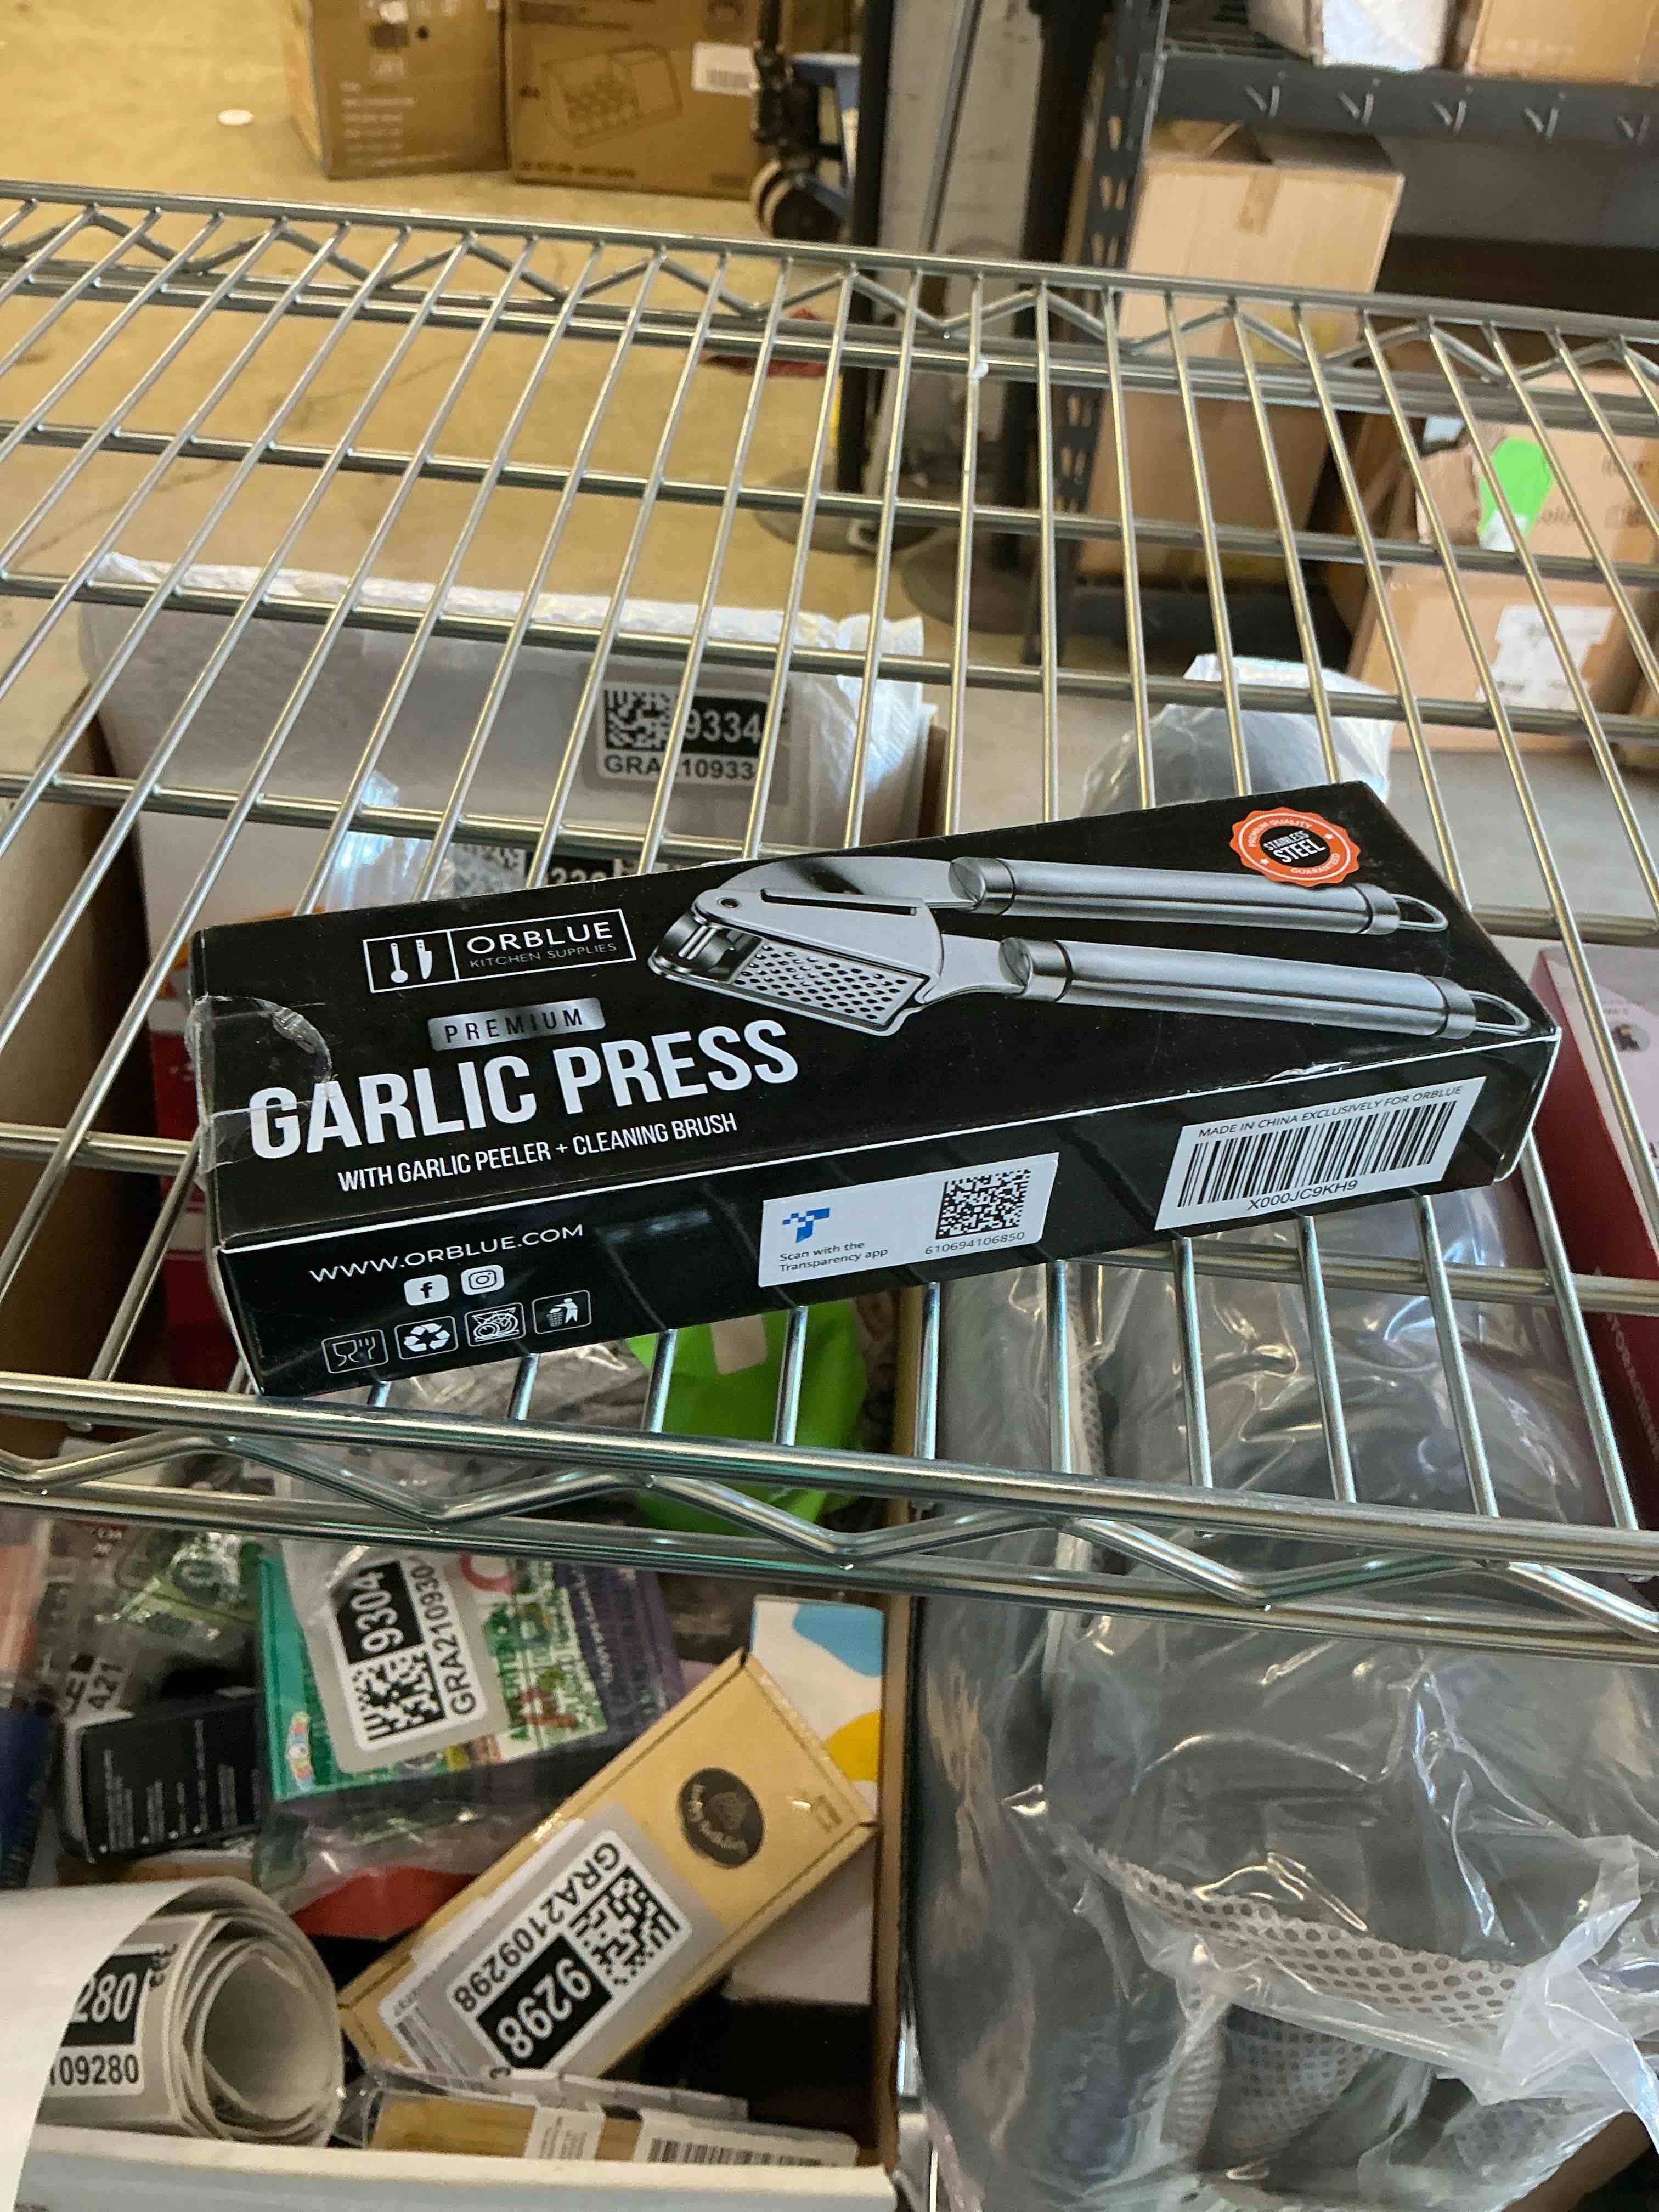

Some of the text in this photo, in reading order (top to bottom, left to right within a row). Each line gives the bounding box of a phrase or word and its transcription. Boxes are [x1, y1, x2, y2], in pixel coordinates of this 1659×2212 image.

[685, 709, 763, 745] 9334
[1263, 830, 1310, 851] STAINLESS
[1269, 819, 1313, 829] QUALITY
[1273, 838, 1326, 863] STEEL
[467, 922, 613, 954] ORBLUE
[469, 943, 618, 968] KITCHEN SUPPLIES
[445, 1008, 584, 1043] PREMIUM
[248, 1019, 798, 1159] GARLIC PRESS
[1198, 1086, 1464, 1137] MADE IN CHINA EXCLUSIVELY FOR ORBLUE
[337, 1112, 737, 1192] WITH GARLIC PEELER + CLEANING BRUSH
[1247, 1179, 1358, 1211] X000JC9KH9
[309, 1224, 583, 1283] WWW.ORBLUE.COM
[780, 1242, 866, 1262] Scan with the
[925, 1232, 1025, 1255] 610694106850
[778, 1249, 889, 1272] Transparency app
[350, 1570, 404, 1654] 9304
[453, 1842, 620, 2012] GRA2109298
[496, 1957, 592, 2059] 9298
